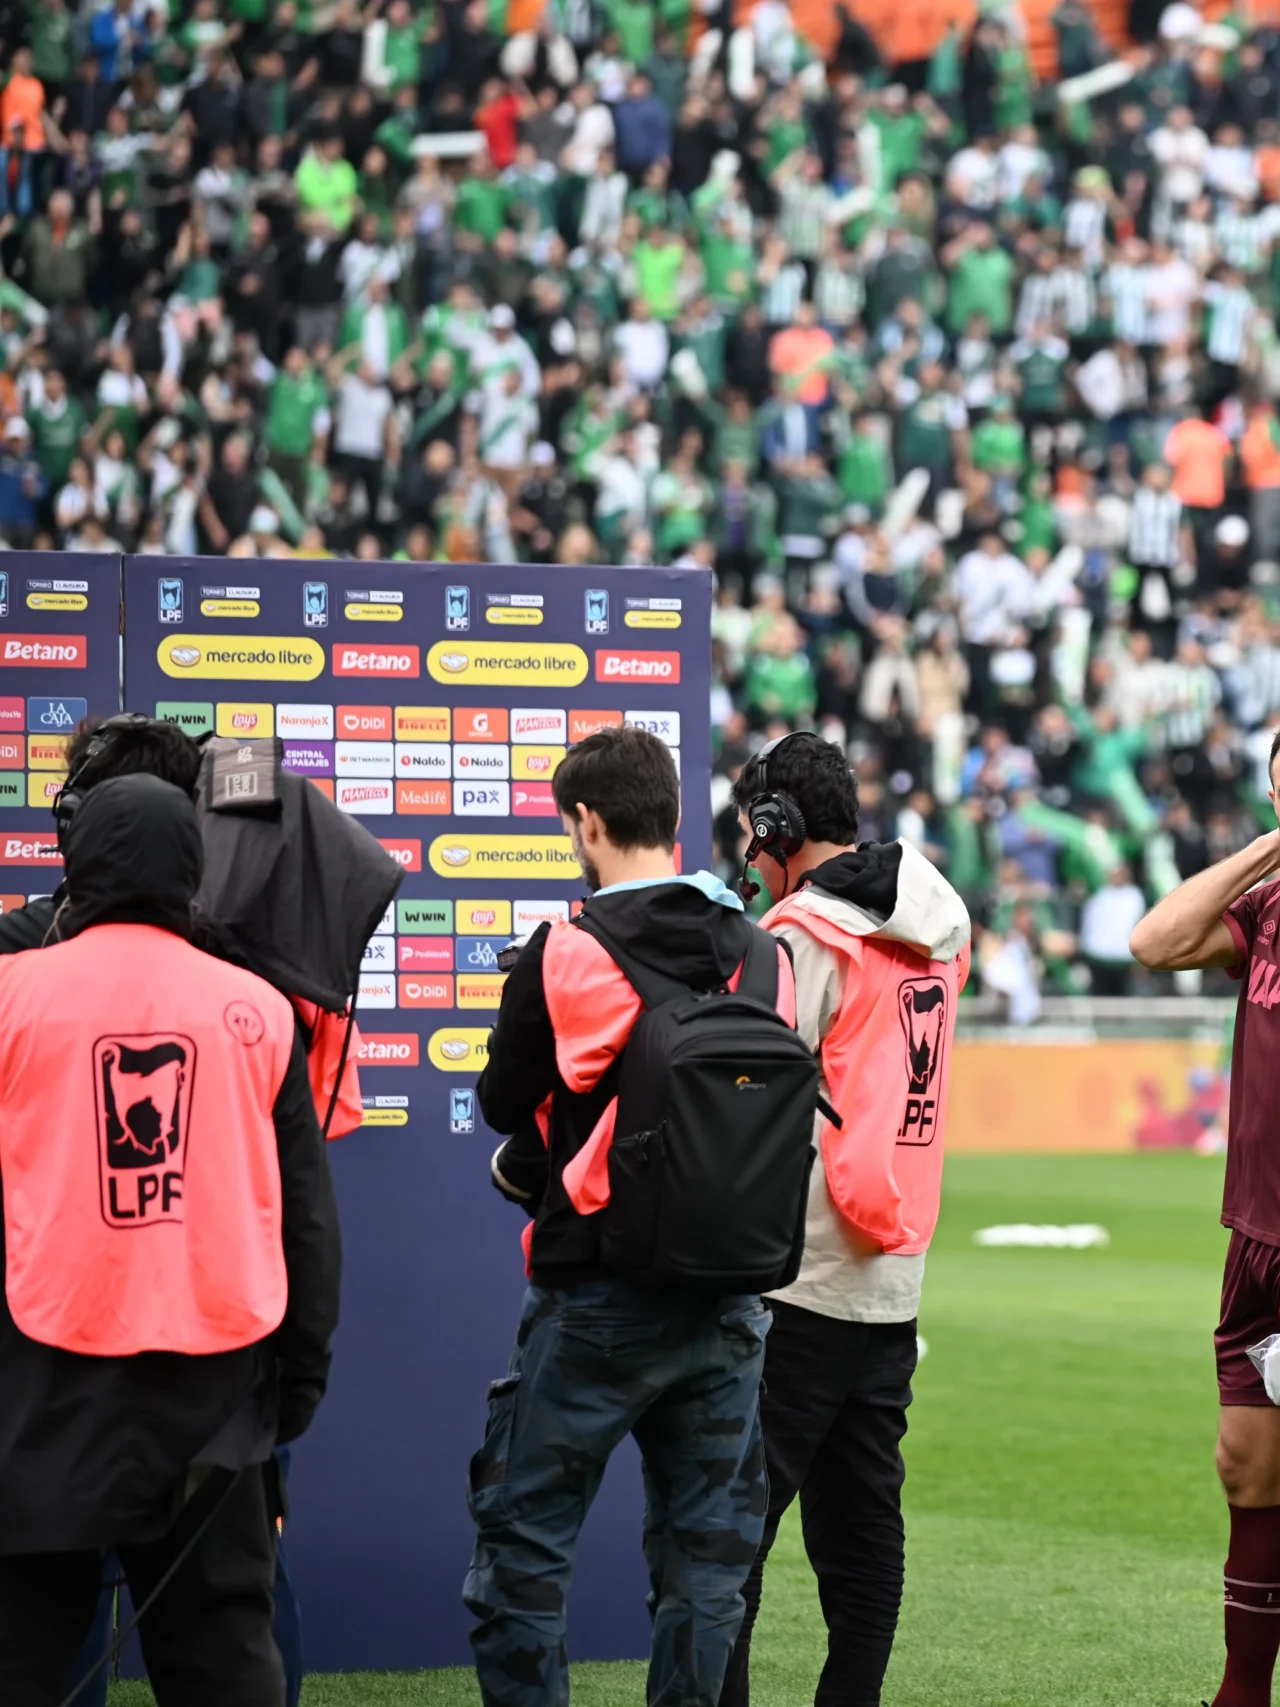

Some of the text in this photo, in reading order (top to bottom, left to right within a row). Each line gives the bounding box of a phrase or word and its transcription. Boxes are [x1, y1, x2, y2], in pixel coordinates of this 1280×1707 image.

[160, 609, 182, 622] LPF
[304, 613, 327, 626] LPF
[447, 617, 469, 629] LPF
[587, 620, 608, 633] LPF
[4, 640, 78, 661] Betano
[206, 649, 313, 665] mercado libre
[341, 650, 412, 671] Betano
[474, 655, 577, 671] mercado libre
[603, 656, 672, 677] Betano
[49, 702, 66, 714] LA
[40, 712, 74, 727] CAJA
[181, 715, 206, 725] WIN
[285, 750, 325, 759] CENTRAL
[412, 755, 446, 766] Naldo
[470, 756, 504, 767] Naldo
[281, 758, 330, 768] DE PASAJES
[400, 789, 447, 805] Medifé
[462, 788, 500, 807] pax
[4, 840, 63, 859] Betan
[476, 848, 543, 863] mercado
[422, 912, 446, 922] WIN
[363, 945, 386, 960] ax
[475, 941, 493, 954] LA
[357, 1041, 411, 1059] etano
[897, 1097, 936, 1138] PF
[451, 1119, 473, 1132] LPF
[108, 1171, 183, 1219] LPF
